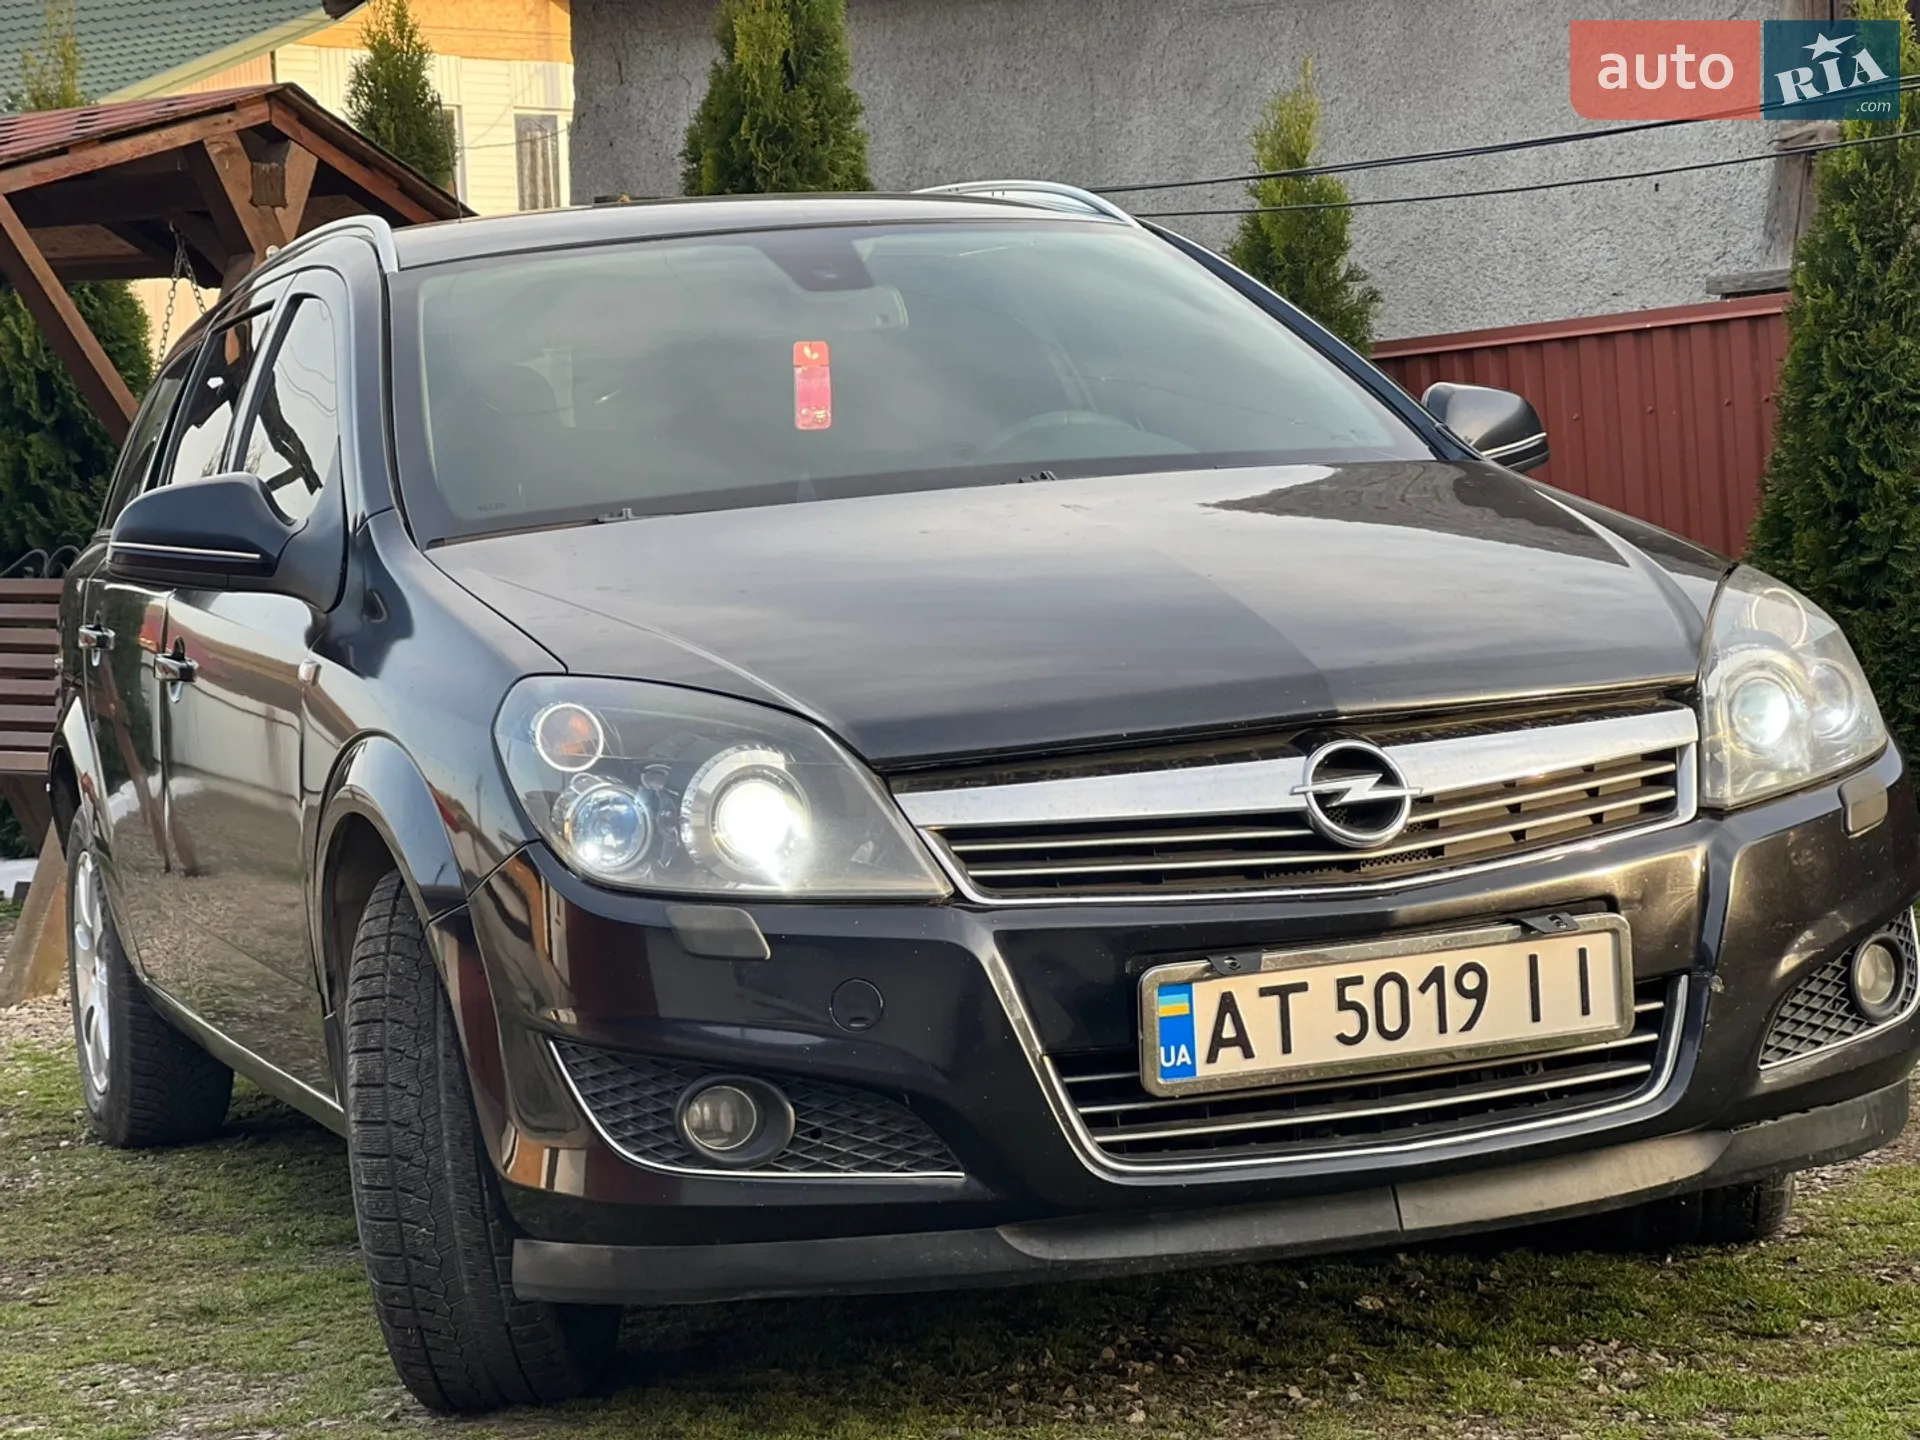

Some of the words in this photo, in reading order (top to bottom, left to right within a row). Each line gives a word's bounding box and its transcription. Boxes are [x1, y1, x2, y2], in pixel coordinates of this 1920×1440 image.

[1205, 981, 1308, 1064] AT
[1335, 961, 1489, 1046] 5019
[1160, 1044, 1192, 1067] UA
